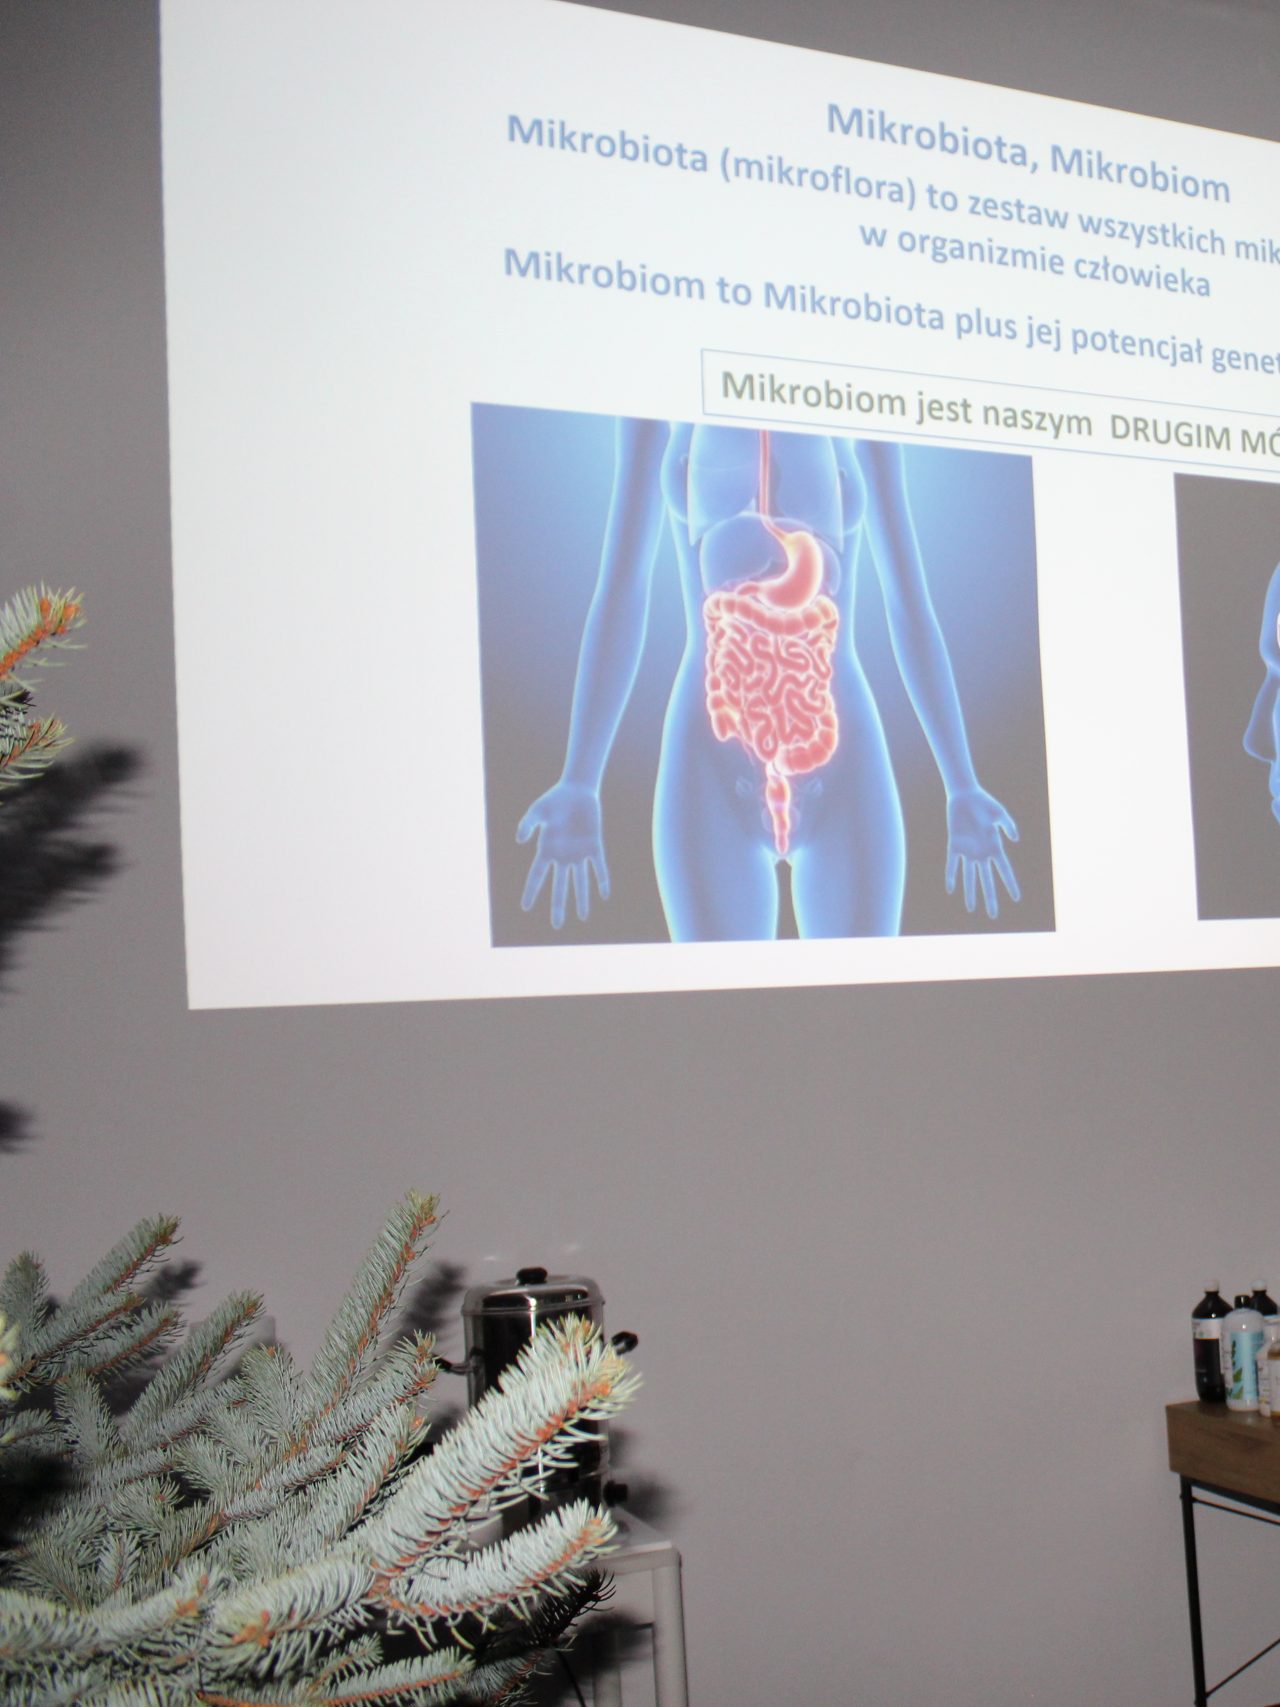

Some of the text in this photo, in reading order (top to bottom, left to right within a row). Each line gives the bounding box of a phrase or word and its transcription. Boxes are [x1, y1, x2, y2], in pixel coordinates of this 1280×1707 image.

[507, 114, 708, 172] Mikrobiota
[720, 146, 916, 211] (mikroflora)
[926, 184, 958, 212] to
[968, 195, 1069, 230] zestaw
[1078, 214, 1225, 255] wszystkich
[827, 103, 1230, 203] Mikrobiota, Mikrobiom
[504, 248, 705, 300] Mikrobiom
[716, 277, 752, 306] to
[764, 281, 944, 330] Mikrobiota
[955, 307, 1018, 340] plus
[1026, 315, 1061, 352] jej
[1072, 328, 1203, 367] potencjał
[859, 225, 1211, 297] w organizmie człowieka
[722, 370, 906, 416] Mikrobiom
[916, 390, 972, 425] jest
[983, 400, 1092, 440] naszym
[1111, 414, 1231, 451] DRUGIM
